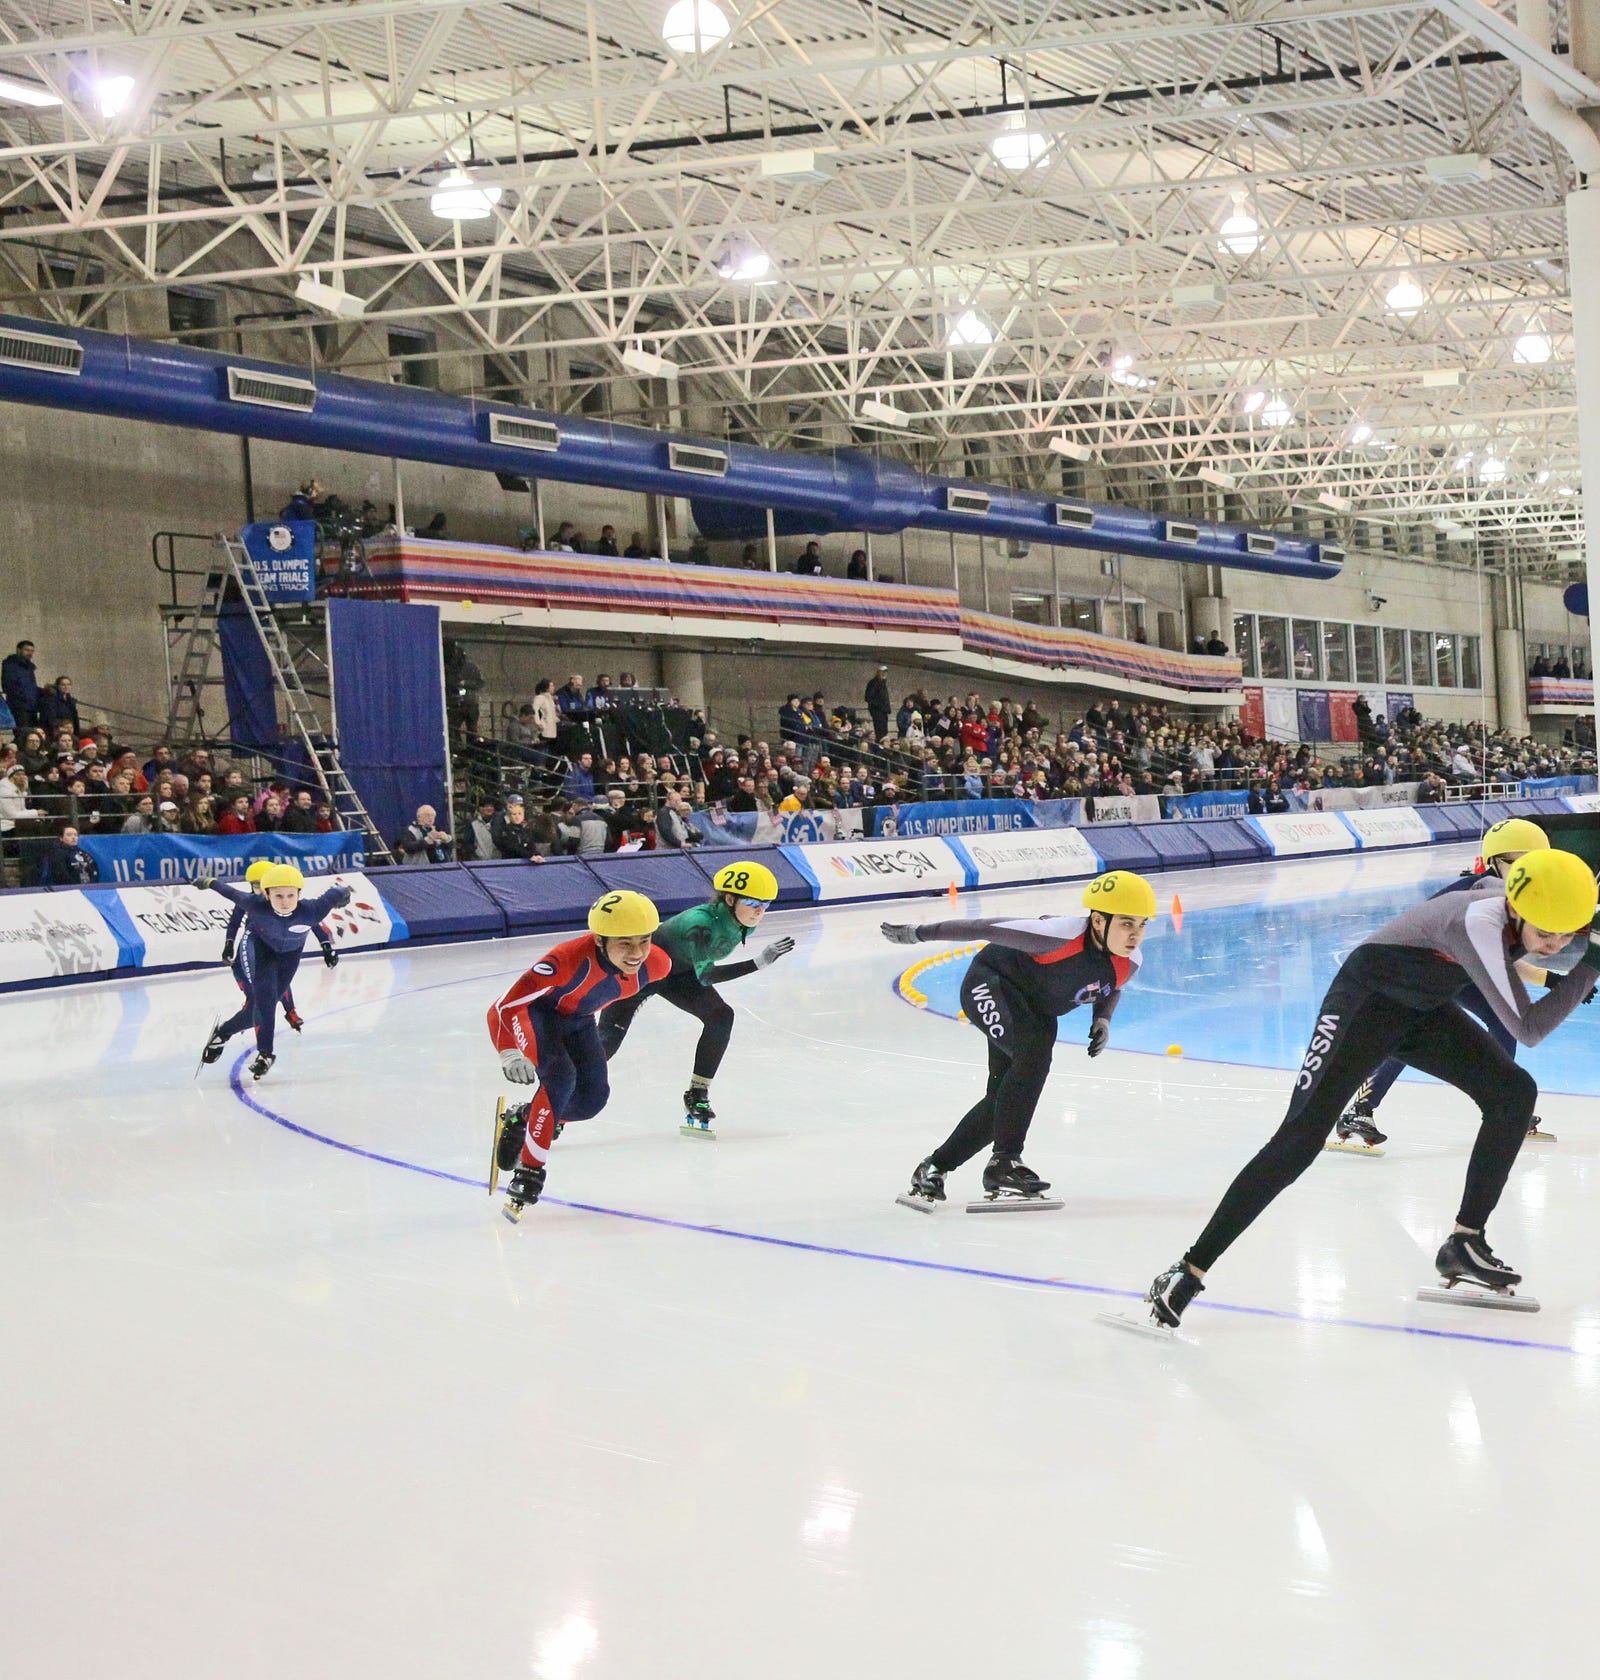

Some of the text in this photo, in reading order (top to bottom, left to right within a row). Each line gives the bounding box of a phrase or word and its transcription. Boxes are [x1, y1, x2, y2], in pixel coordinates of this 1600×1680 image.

[272, 559, 309, 571] OLYMPIC
[278, 571, 309, 583] TRIALS
[280, 583, 309, 591] TRACK
[926, 815, 964, 835] OLYMPIC
[964, 814, 989, 833] TEAM
[992, 813, 1022, 831] TRIALS
[113, 858, 145, 881] US
[160, 856, 244, 880] OLYMPIC
[722, 870, 750, 891] 28
[1090, 875, 1118, 894] 56
[1508, 867, 1533, 901] 31
[971, 982, 1005, 1039] WSSC
[1296, 1014, 1341, 1090] WSSC
